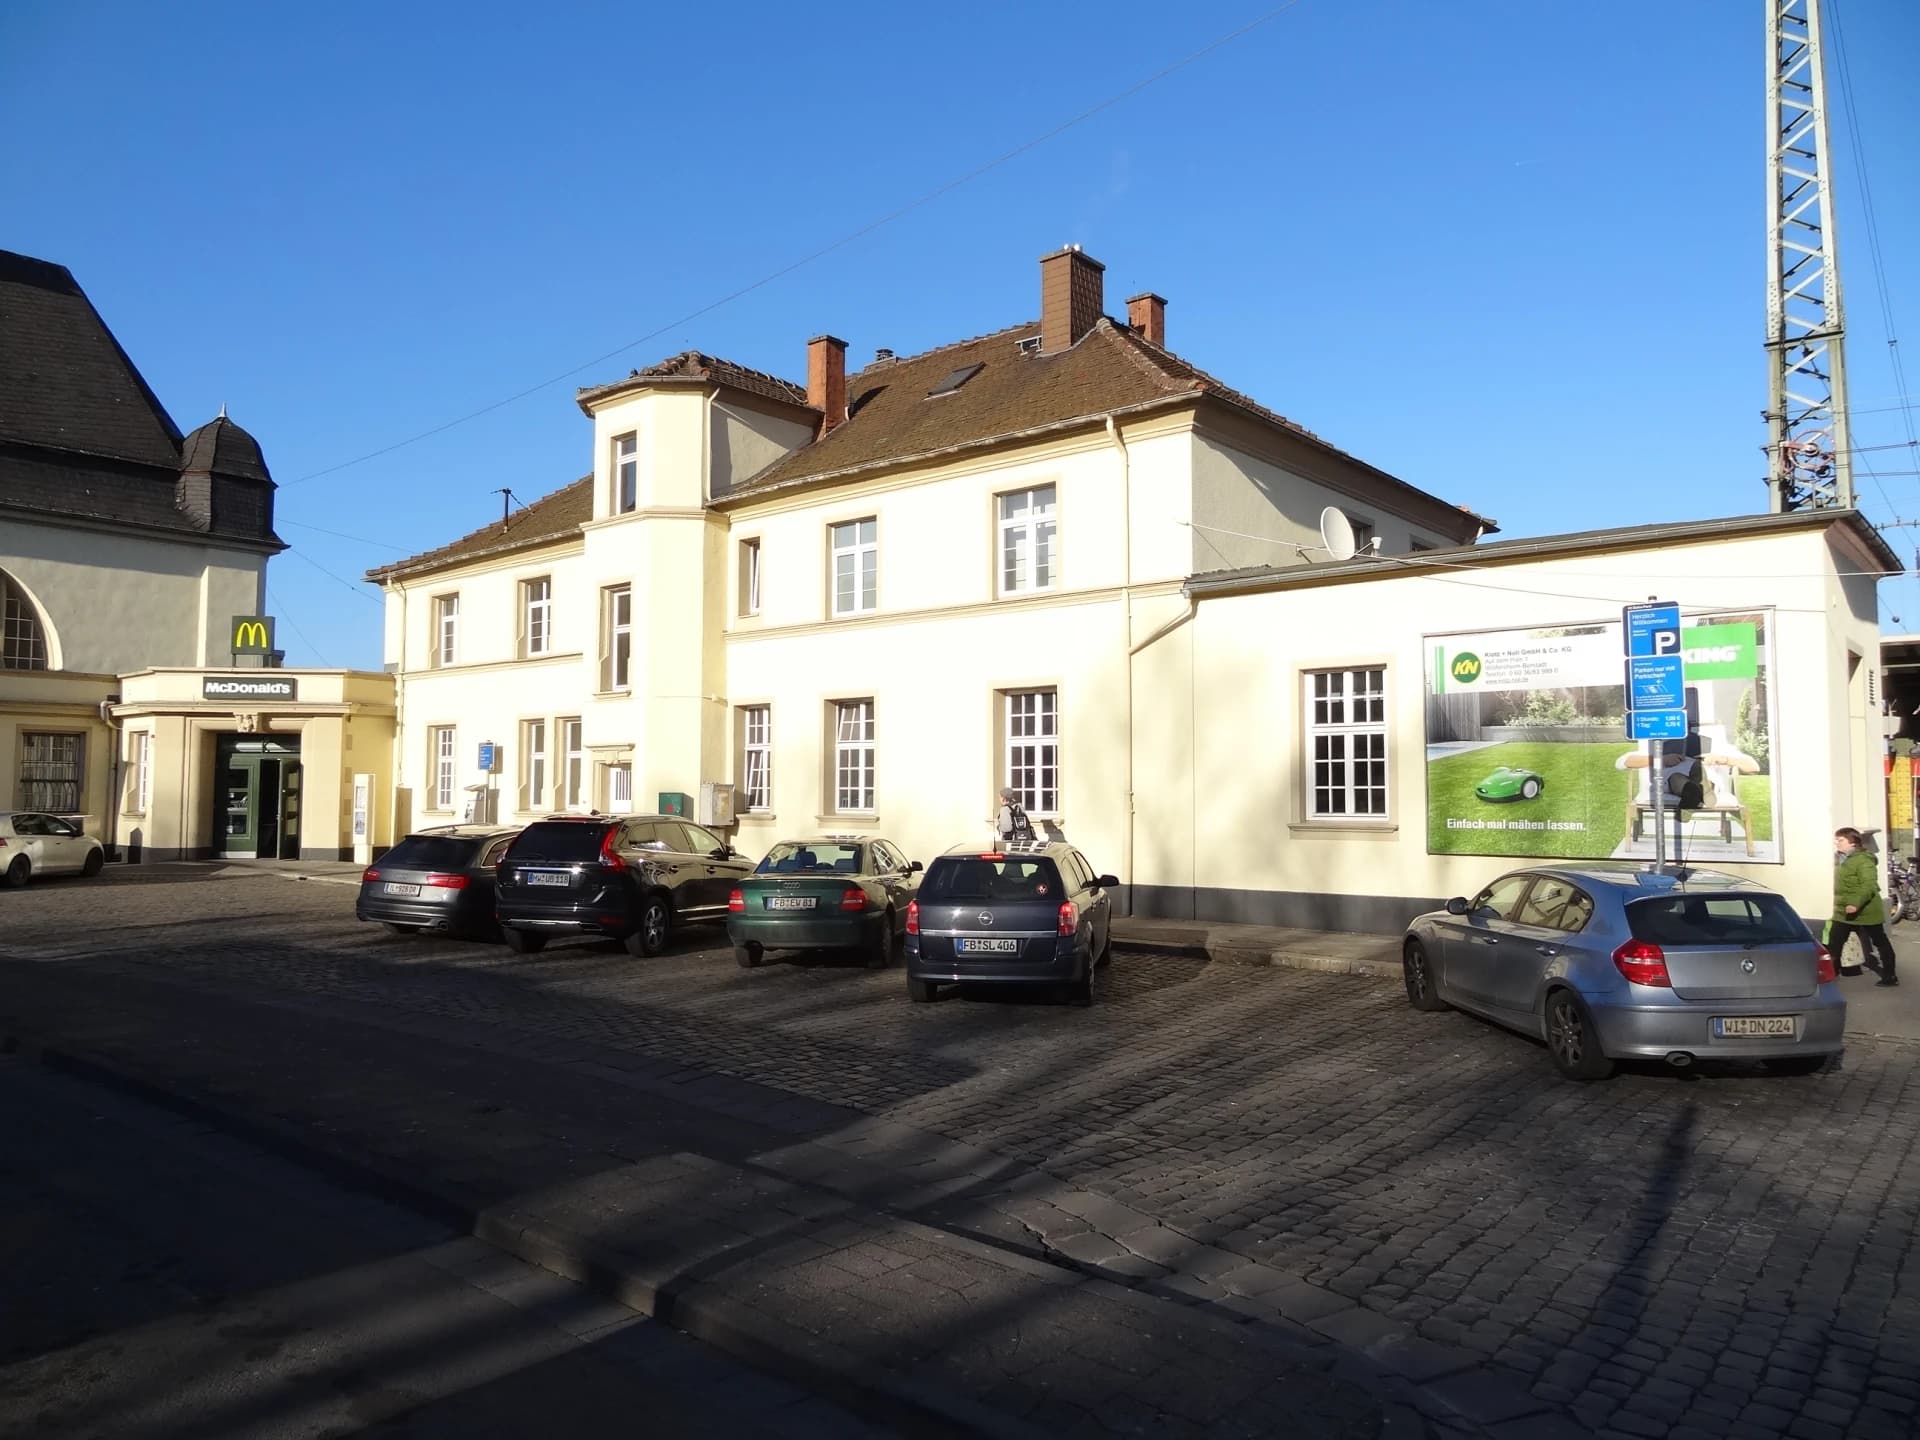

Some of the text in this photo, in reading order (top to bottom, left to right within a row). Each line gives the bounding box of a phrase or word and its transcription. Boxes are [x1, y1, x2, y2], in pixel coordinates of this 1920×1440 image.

[1655, 631, 1676, 656] P
[1454, 659, 1479, 675] KN
[205, 682, 290, 694] McDonald's
[1447, 818, 1587, 831] Einfach mal mähen lassen.
[963, 940, 1015, 950] FB SL 406
[1724, 1020, 1790, 1033] WI DN 224
